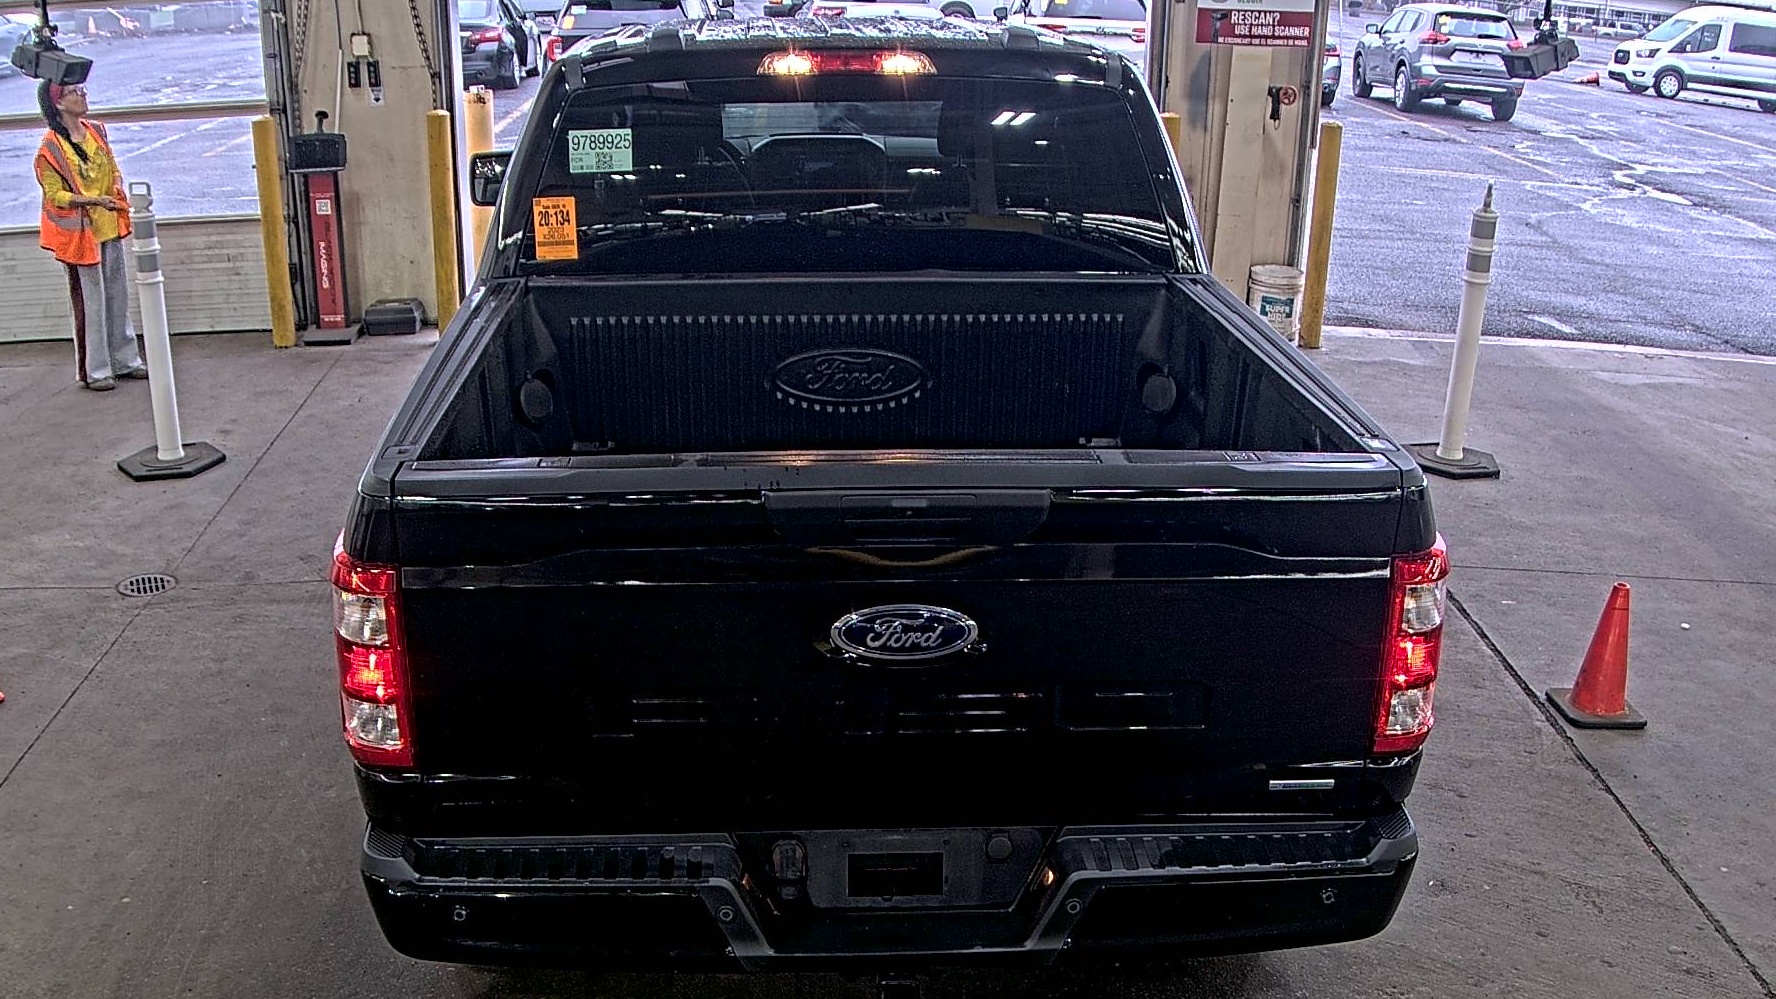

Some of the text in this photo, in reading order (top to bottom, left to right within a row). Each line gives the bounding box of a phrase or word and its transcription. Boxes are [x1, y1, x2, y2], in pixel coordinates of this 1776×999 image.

[1231, 11, 1280, 25] RESCAN?
[1235, 25, 1309, 37] USE HAND SCANNER
[571, 132, 632, 151] 9789925
[538, 209, 571, 227] 20:134
[805, 355, 895, 390] Ford
[866, 617, 944, 648] Ford
